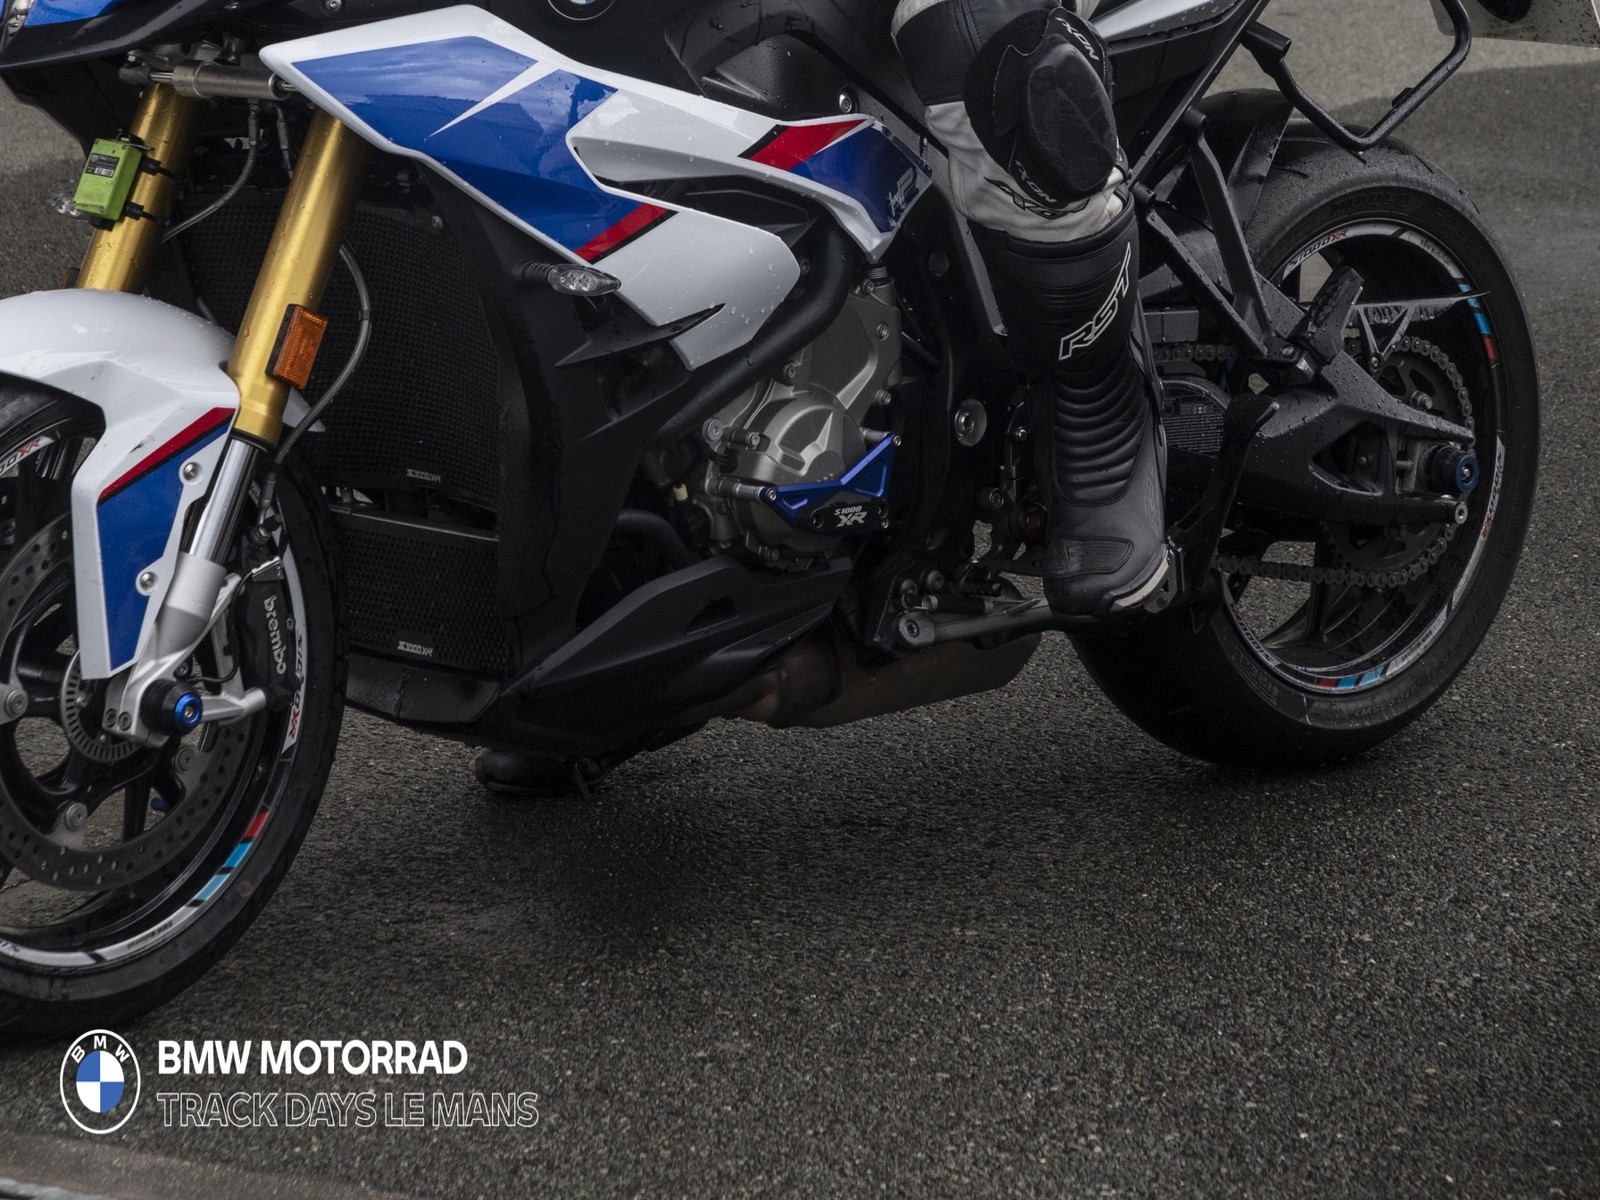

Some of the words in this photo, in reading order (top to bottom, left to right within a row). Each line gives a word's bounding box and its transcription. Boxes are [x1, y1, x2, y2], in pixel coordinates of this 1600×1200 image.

[1059, 241, 1132, 361] RST
[834, 505, 863, 517] S1000
[836, 511, 868, 528] XR
[264, 594, 287, 675] brembo
